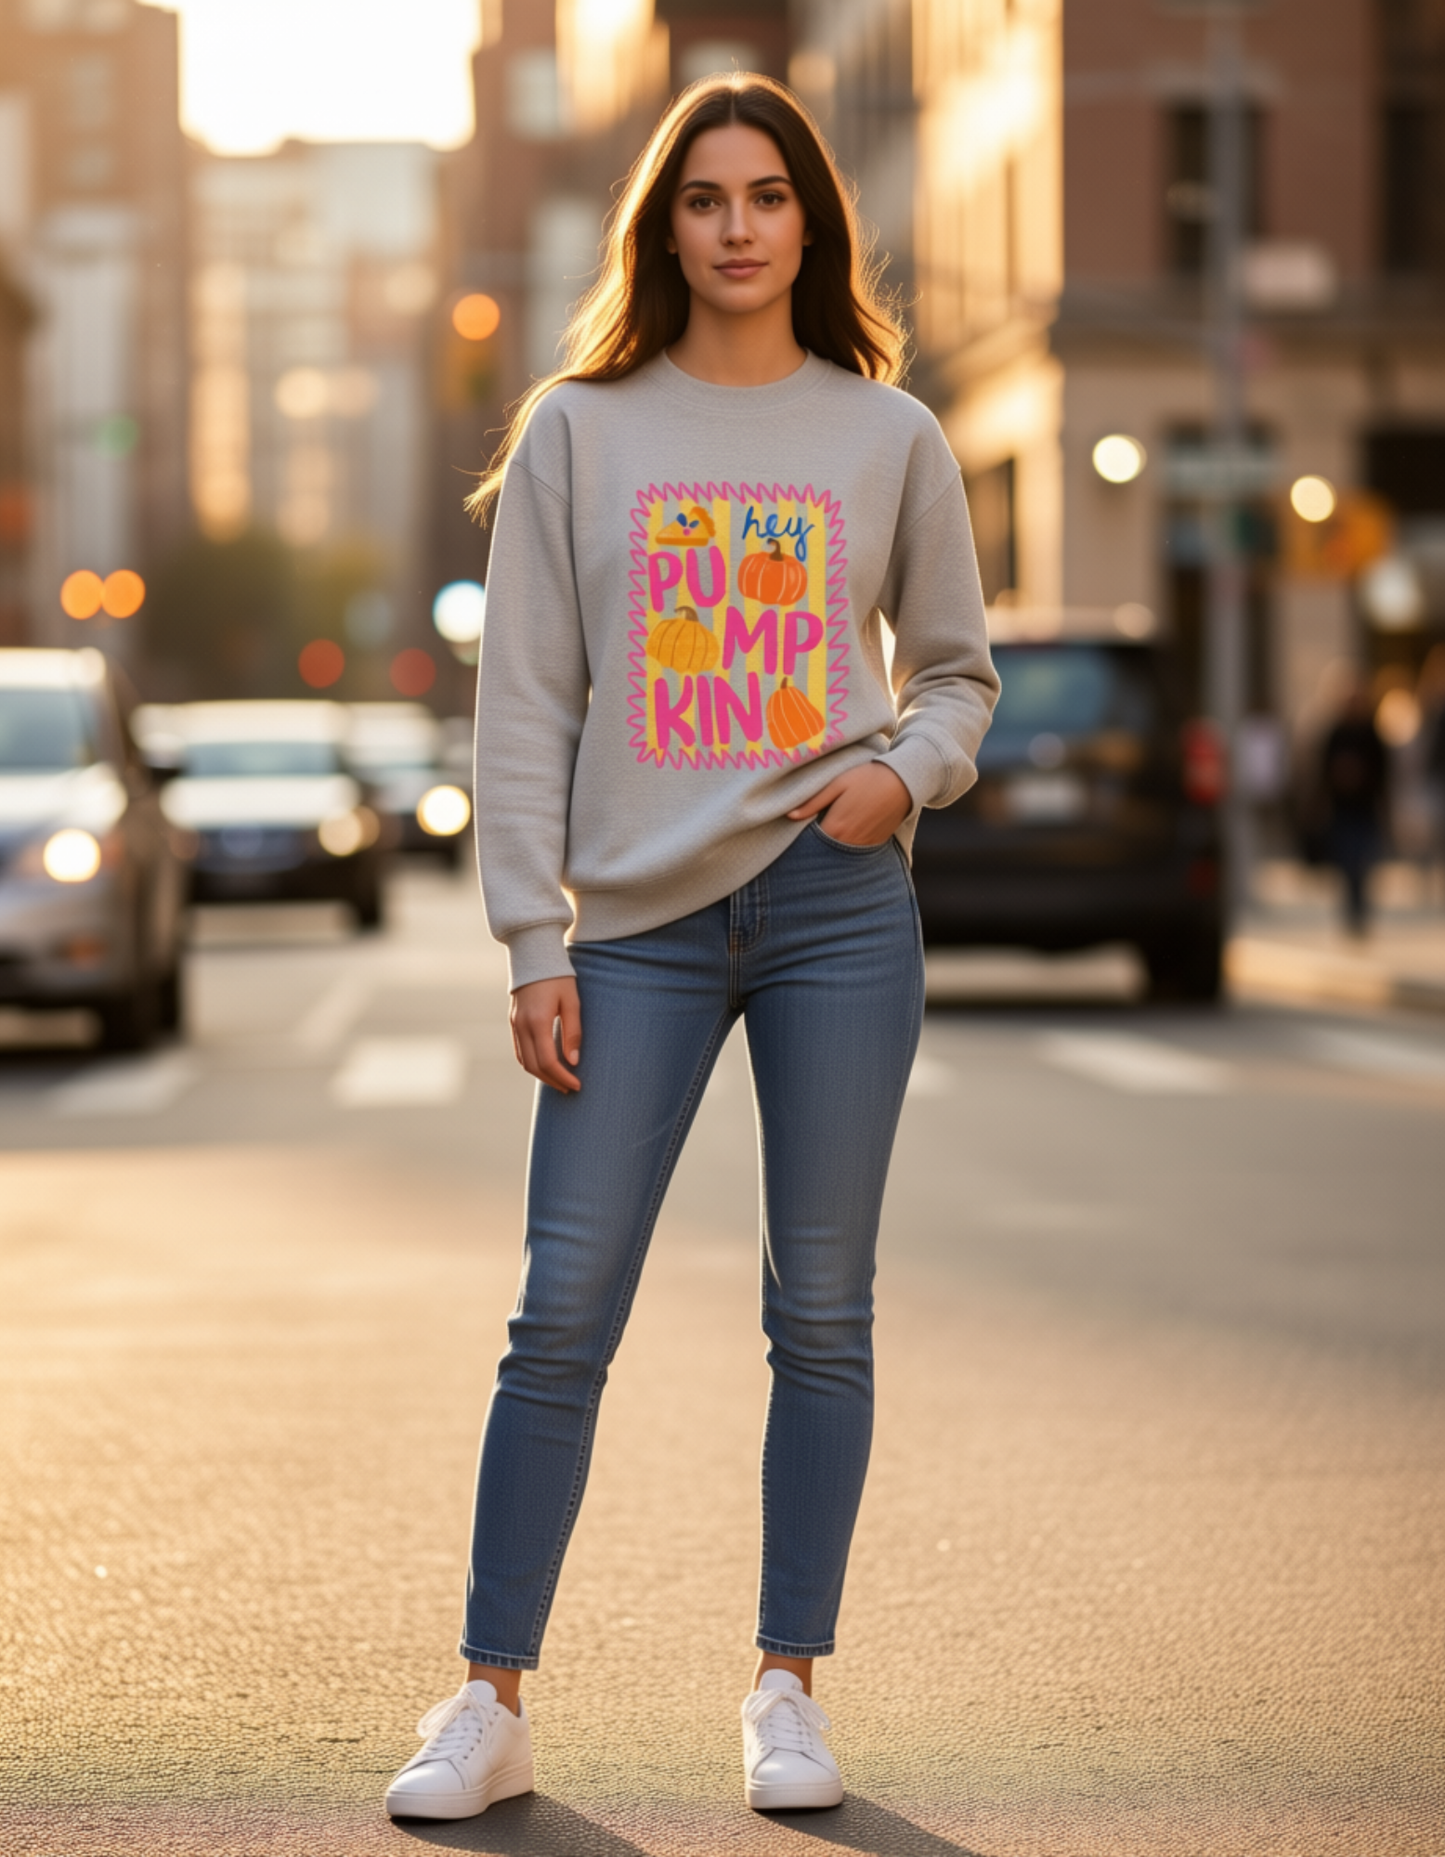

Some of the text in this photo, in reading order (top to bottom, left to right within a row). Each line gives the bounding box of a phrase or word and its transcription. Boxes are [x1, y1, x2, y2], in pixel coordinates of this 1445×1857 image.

[742, 506, 815, 562] hey
[648, 546, 726, 612] PU
[722, 606, 824, 675] MP
[654, 672, 763, 748] KIN
